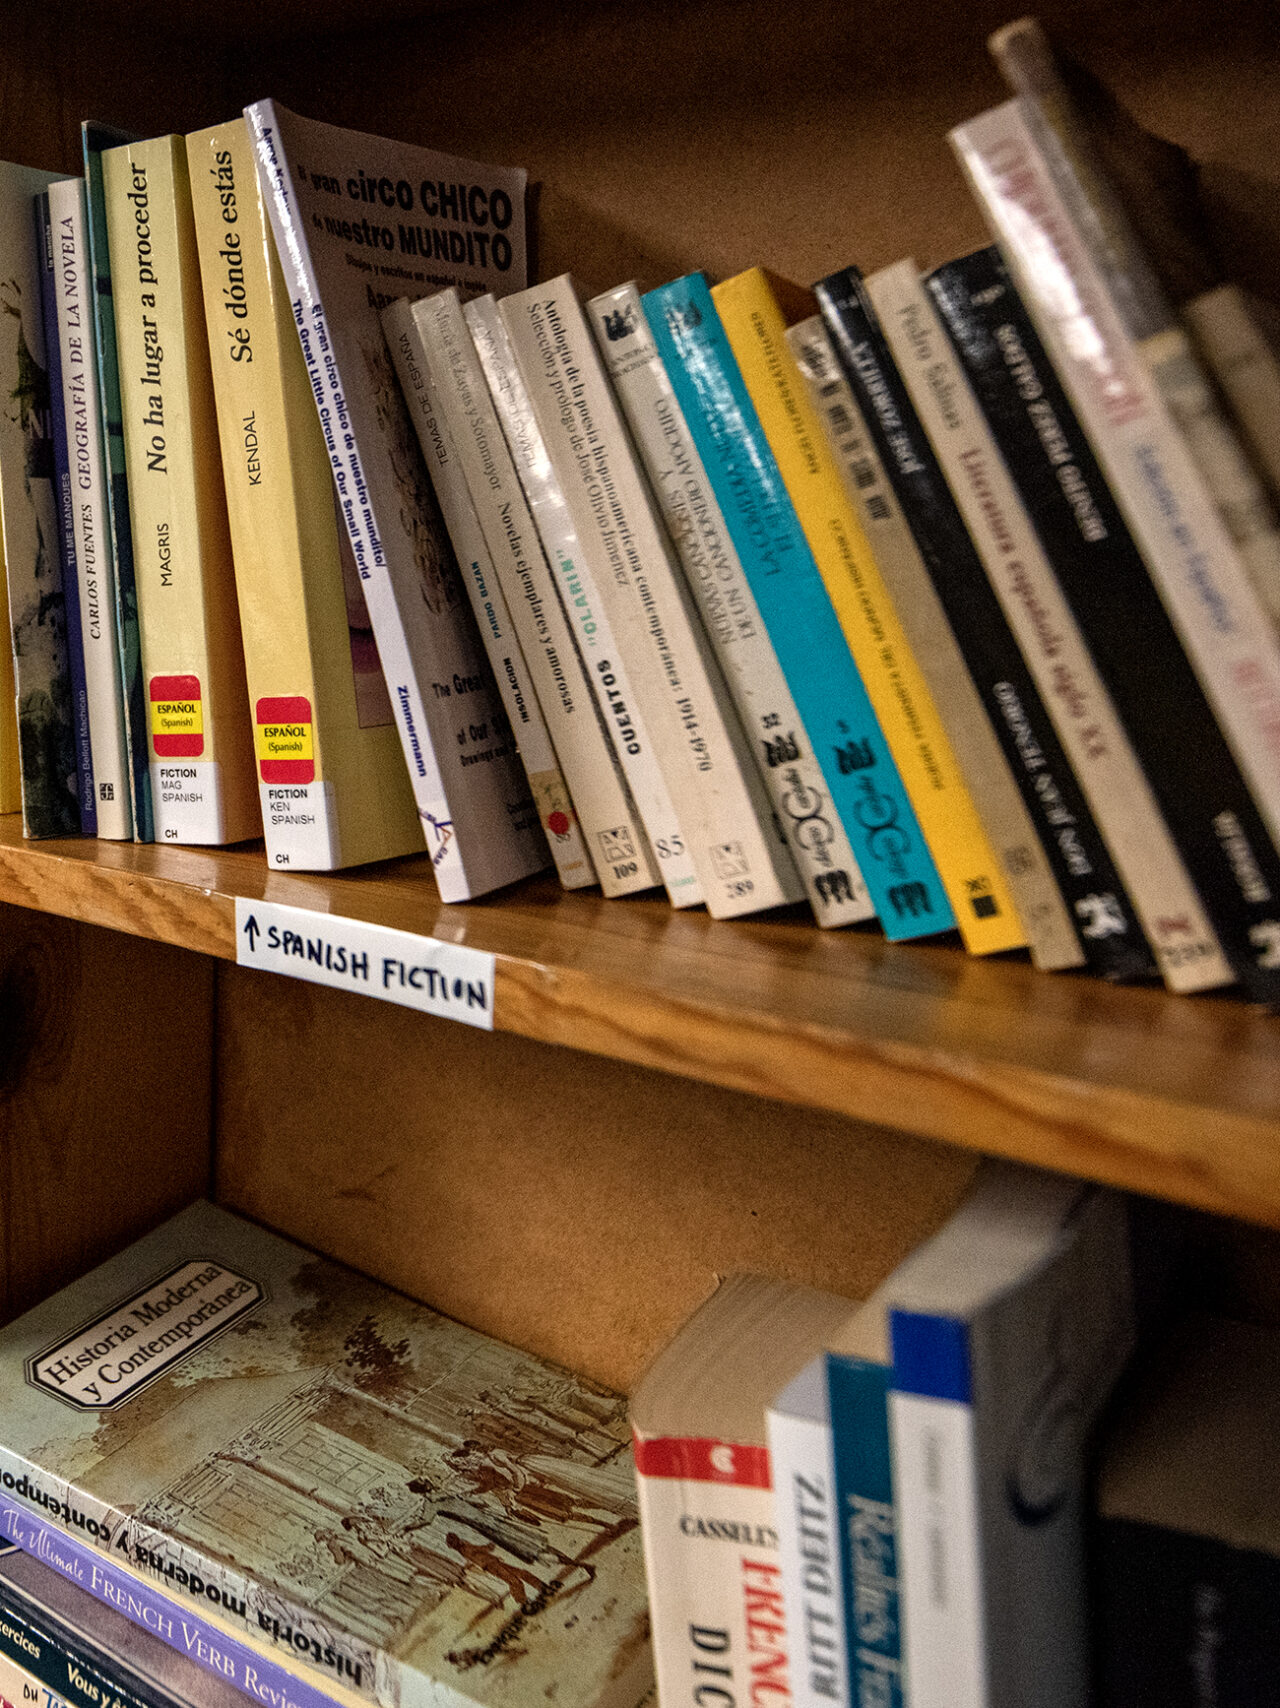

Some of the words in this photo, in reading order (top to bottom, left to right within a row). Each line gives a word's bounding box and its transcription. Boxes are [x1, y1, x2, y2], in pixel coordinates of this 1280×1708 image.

[214, 150, 239, 225] estás
[346, 169, 414, 211] circo
[420, 180, 513, 230] CHICO
[128, 162, 159, 285] proceder
[61, 216, 78, 298] NOVELA
[325, 217, 394, 250] nuestro
[398, 223, 513, 272] MUNDITO
[224, 232, 249, 320] dónde
[67, 303, 80, 329] LA
[145, 293, 156, 309] a
[293, 298, 304, 325] The
[70, 336, 83, 364] DE
[141, 317, 168, 387] lugar
[231, 328, 253, 364] Sé
[300, 328, 316, 366] Great
[527, 303, 556, 373] Selección
[544, 300, 572, 365] Antología
[323, 354, 339, 389] circo
[399, 332, 422, 390] ESPAÑA
[545, 371, 559, 379] y
[565, 366, 580, 383] de
[310, 369, 324, 405] Little
[419, 393, 432, 415] DE
[571, 383, 586, 398] la
[143, 395, 164, 426] ha
[333, 391, 349, 430] chico
[549, 381, 577, 434] prólogo
[574, 400, 599, 444] poesía
[69, 373, 91, 490] GEOGRAFÍA
[249, 411, 262, 486] KENDAL
[320, 407, 336, 452] Circus
[344, 433, 355, 450] de
[427, 417, 449, 468] TEMAS
[514, 420, 537, 469] TEMAS
[570, 436, 586, 451] de
[147, 435, 168, 475] No
[331, 454, 343, 468] of
[471, 416, 502, 491] Sotomayor
[576, 450, 596, 484] José
[336, 471, 349, 496] Our
[349, 453, 367, 505] nuestro
[658, 470, 673, 481] Y
[62, 472, 73, 529] MANQUES
[344, 499, 361, 538] Small
[587, 484, 609, 527] Olivio
[592, 444, 642, 573] hispanoamericana
[65, 531, 74, 548] ME
[68, 551, 76, 566] TU
[81, 504, 97, 575] FUENTES
[157, 523, 172, 587] MAGRIS
[354, 540, 371, 580] World
[471, 561, 488, 598] BAZAN
[88, 578, 101, 639] CARLOS
[485, 602, 502, 639] PARDO
[498, 502, 521, 558] Novelas
[517, 560, 548, 635] ejemplares
[539, 636, 553, 645] y
[546, 646, 576, 714] amorosas
[157, 702, 196, 714] ESPAÑOL
[503, 657, 530, 723] INSOLACION
[597, 659, 641, 756] CUENTOS
[161, 718, 193, 728] (Spanish)
[264, 725, 307, 737] ESPAÑOL
[397, 685, 427, 777] Zimmermann
[268, 741, 303, 753] (Spanish)
[84, 773, 93, 811] Rodrigo
[160, 769, 197, 778] FICTION
[161, 780, 182, 790] MAG
[162, 793, 203, 802] SPANISH
[268, 789, 308, 799] FICTION
[270, 802, 290, 812] KEN
[165, 829, 178, 839] CH
[271, 815, 315, 825] SPANISH
[275, 854, 290, 864] CH
[655, 835, 685, 859] 85
[267, 925, 369, 981] SPANISH
[383, 958, 487, 1010] FICTION
[44, 1322, 138, 1386] Historia
[130, 1265, 222, 1327] Moderna
[82, 1382, 103, 1403] y
[97, 1279, 253, 1385] Contemporánea
[115, 1530, 130, 1554] y
[3, 1508, 24, 1543] The
[29, 1525, 85, 1582] Ultimate
[90, 1566, 173, 1639] FRENCH
[181, 1621, 236, 1678] VERB
[135, 1541, 248, 1618] moderna
[257, 1609, 363, 1687] historia
[67, 1662, 100, 1701] Vous
